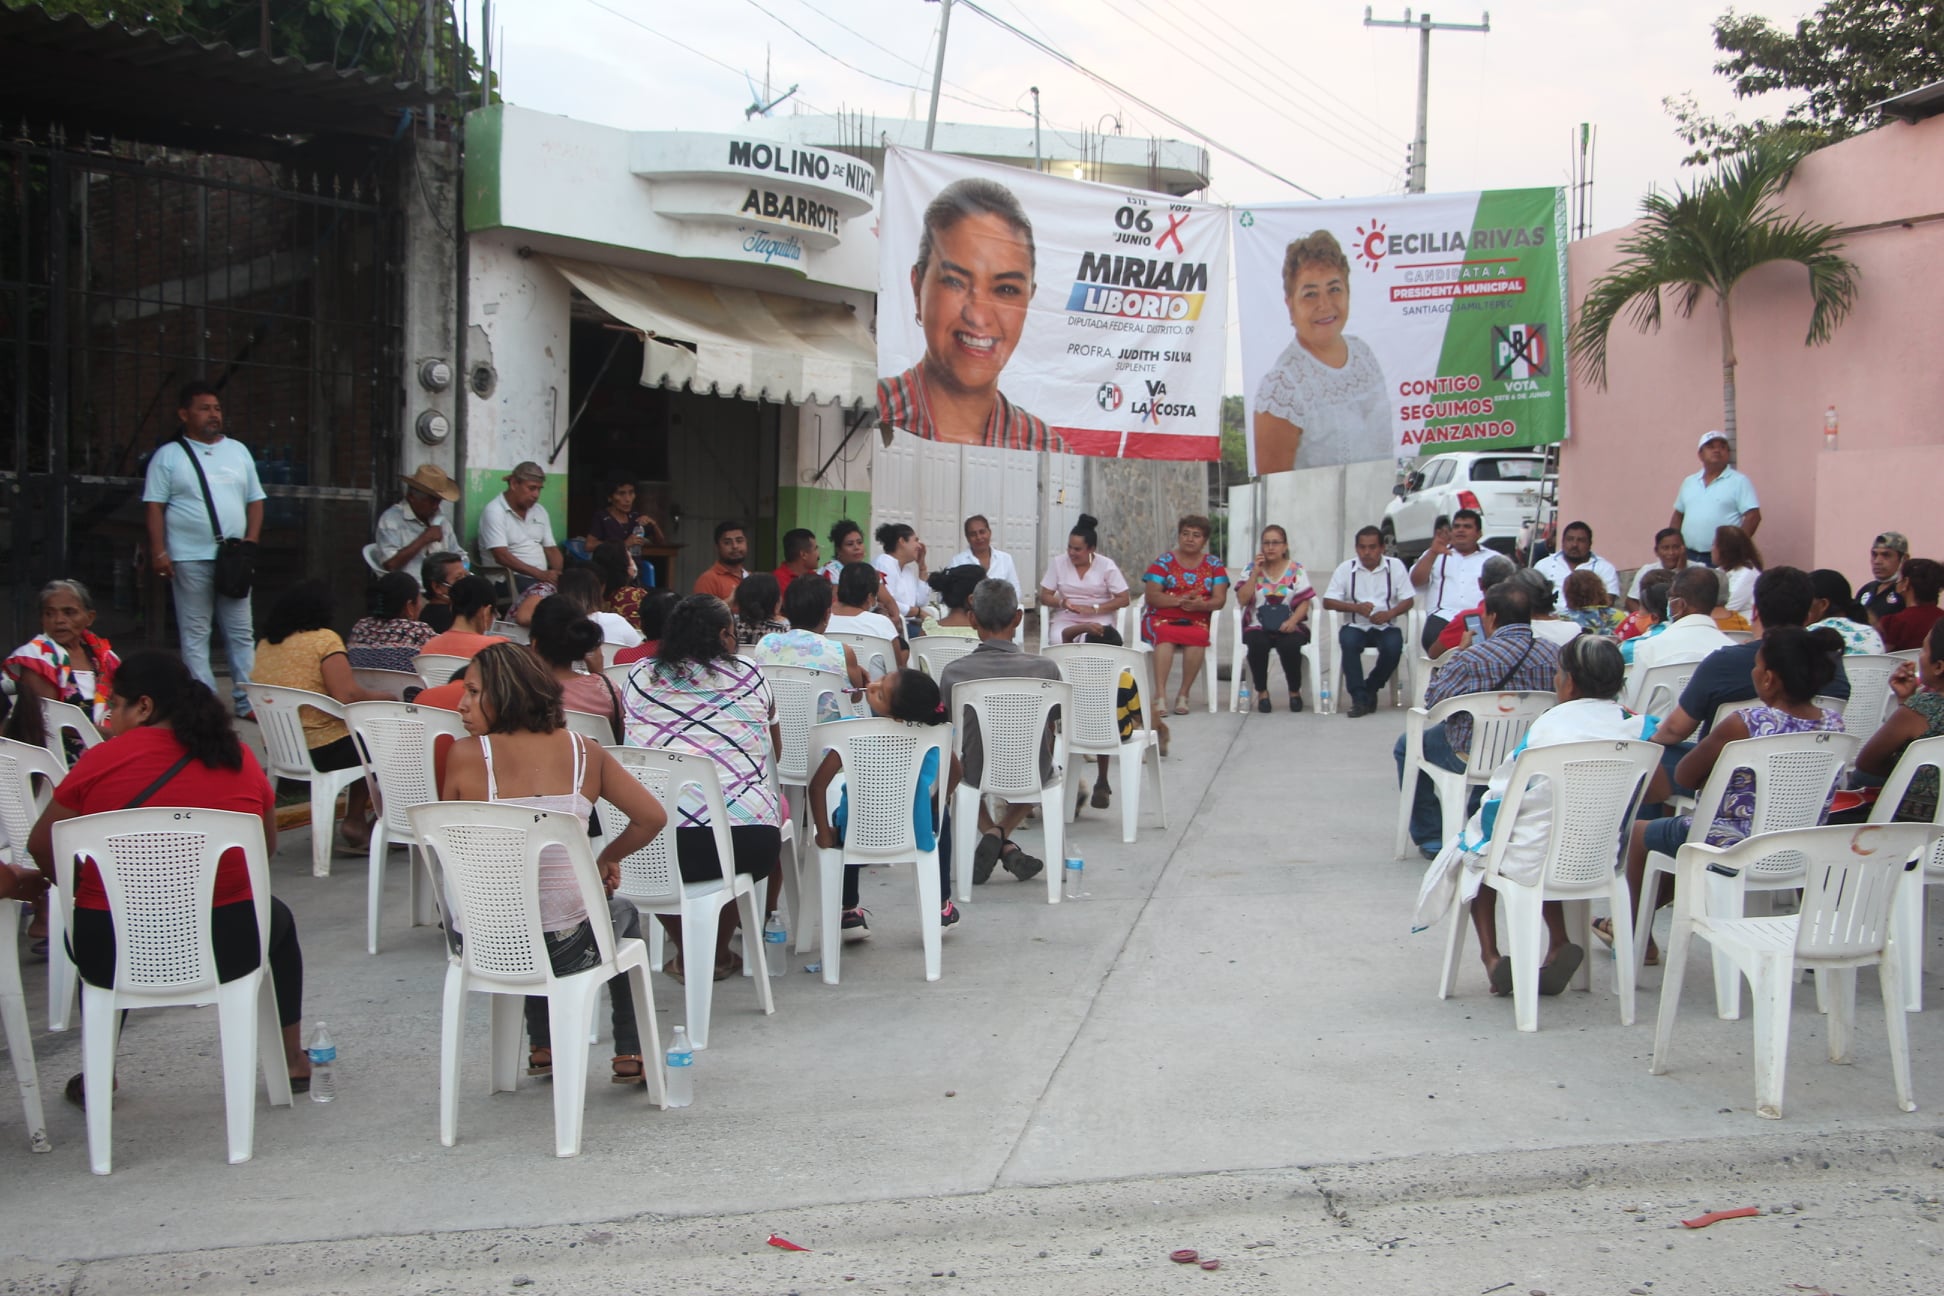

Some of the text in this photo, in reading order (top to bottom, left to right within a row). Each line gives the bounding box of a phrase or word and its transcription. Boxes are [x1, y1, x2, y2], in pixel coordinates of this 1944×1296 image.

[728, 141, 829, 180] MOLINO
[832, 164, 845, 177] DE
[1169, 203, 1192, 213] VOTA
[1115, 206, 1153, 233] 06
[1115, 233, 1151, 246] JUNIO
[1364, 227, 1545, 261] CECILIA RIVAS
[1076, 251, 1208, 292] MIRIAM
[1404, 265, 1507, 283] CANDIDATA A
[1393, 281, 1522, 299] PRESIDENTA MUNICIPAL
[1083, 287, 1189, 320] LIBORIO
[1402, 303, 1453, 316] SANTIAGO
[1067, 316, 1108, 329] DIPUTADA
[1108, 320, 1145, 333] FEDERAL
[1118, 348, 1160, 361] JUDITH
[1163, 350, 1192, 363] SILVA
[1115, 362, 1157, 372] SUPLENTE
[1145, 380, 1167, 397] VA
[1400, 375, 1481, 396] CONTIGO
[1504, 380, 1539, 392] VOTA
[1131, 402, 1148, 414] LA
[1155, 403, 1196, 417] COSTA
[1400, 398, 1493, 421] SEGUIMOS
[1401, 421, 1515, 445] AVANZANDO
